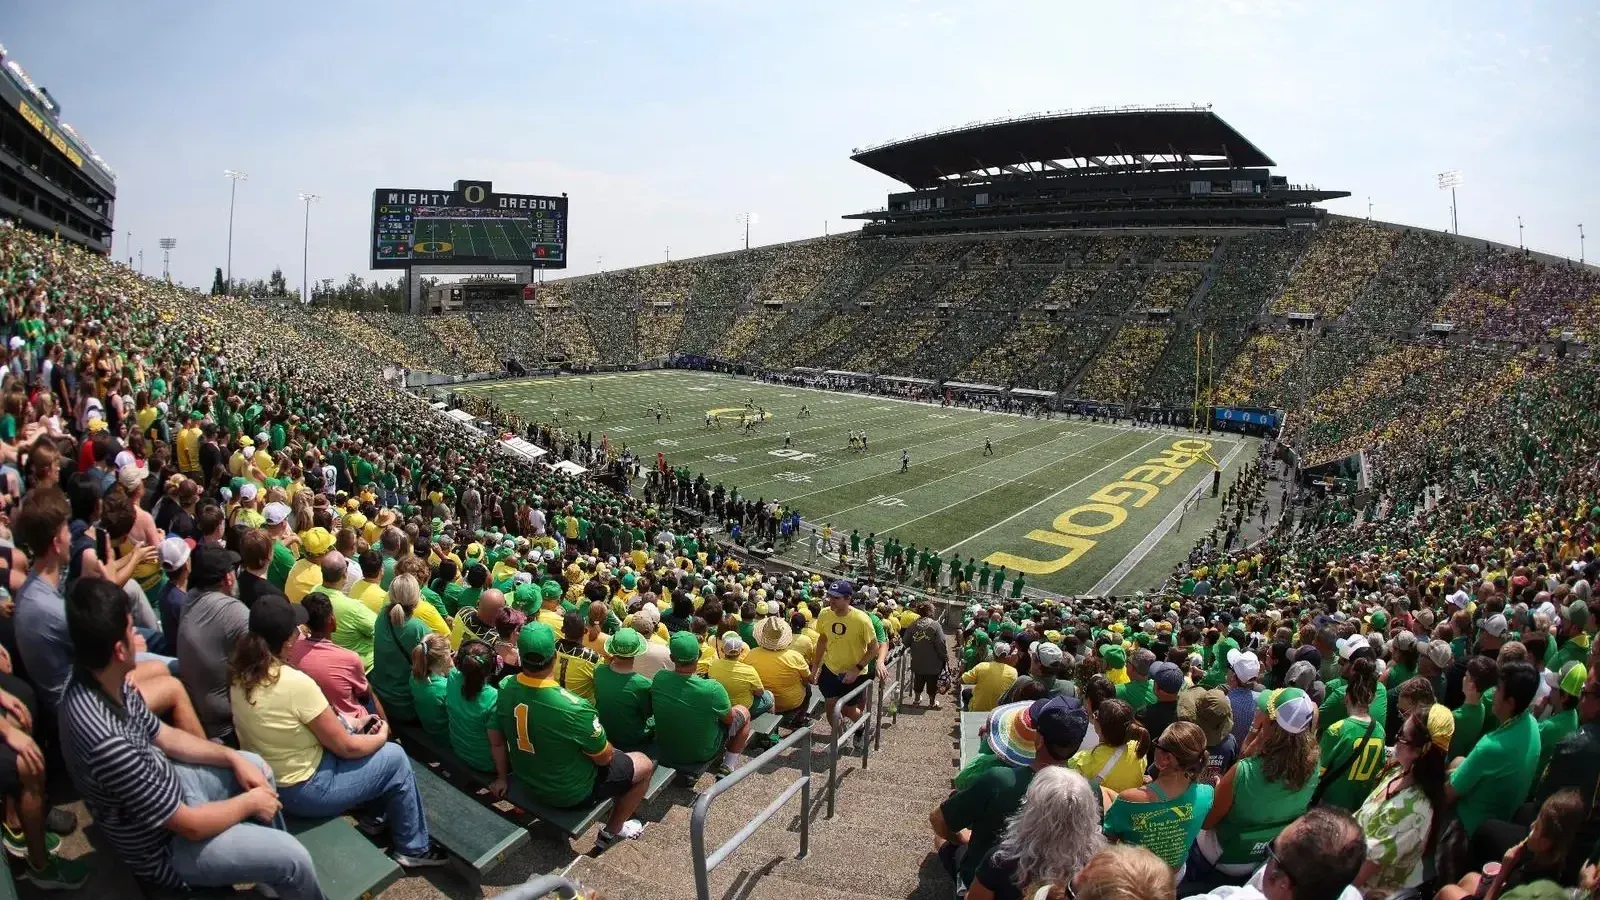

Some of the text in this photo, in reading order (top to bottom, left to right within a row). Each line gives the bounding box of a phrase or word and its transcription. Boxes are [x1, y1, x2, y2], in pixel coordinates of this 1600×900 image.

[388, 193, 556, 210] MIGHTY OREGON
[465, 185, 485, 203] O
[982, 439, 1212, 574] OREGON
[831, 622, 847, 636] O
[514, 702, 535, 754] 1
[1347, 737, 1383, 781] 10
